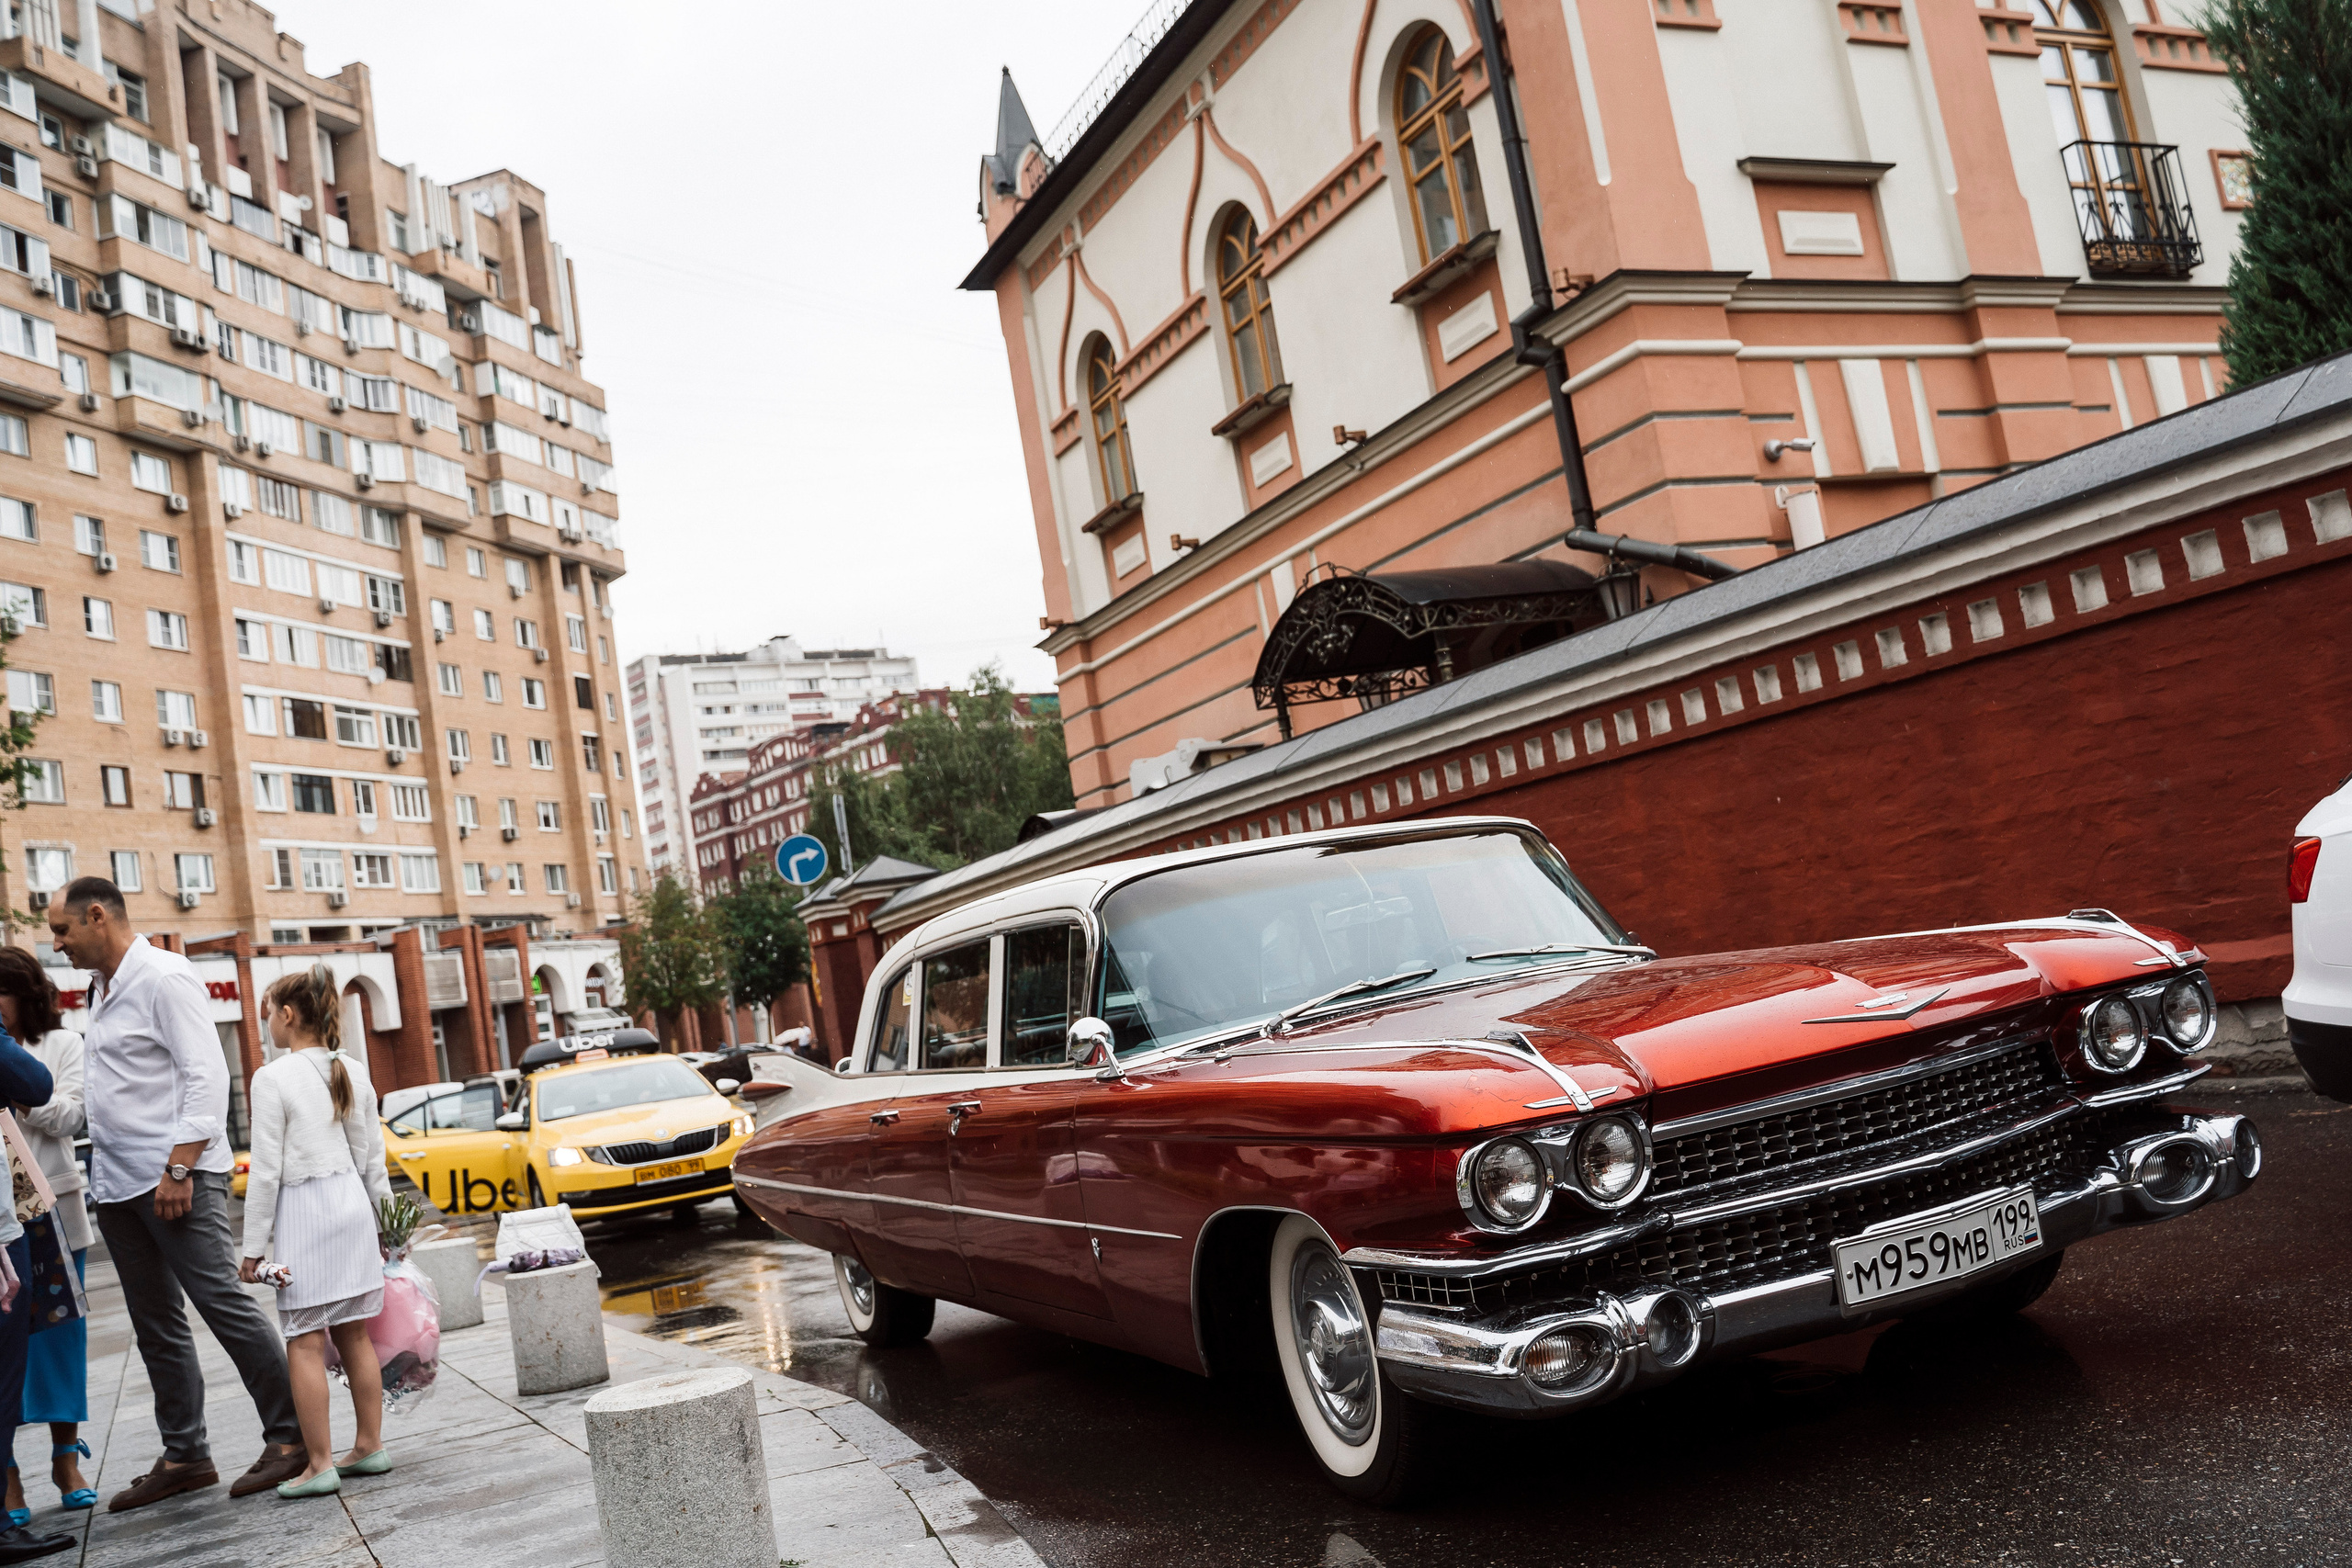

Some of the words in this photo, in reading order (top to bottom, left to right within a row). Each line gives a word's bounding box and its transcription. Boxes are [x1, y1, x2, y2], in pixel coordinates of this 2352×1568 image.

[559, 1032, 616, 1053] Uber
[423, 1168, 517, 1213] Ube
[1853, 1226, 1989, 1294] М959МВ
[1992, 1198, 2030, 1239] 199
[2004, 1235, 2025, 1251] RUS
